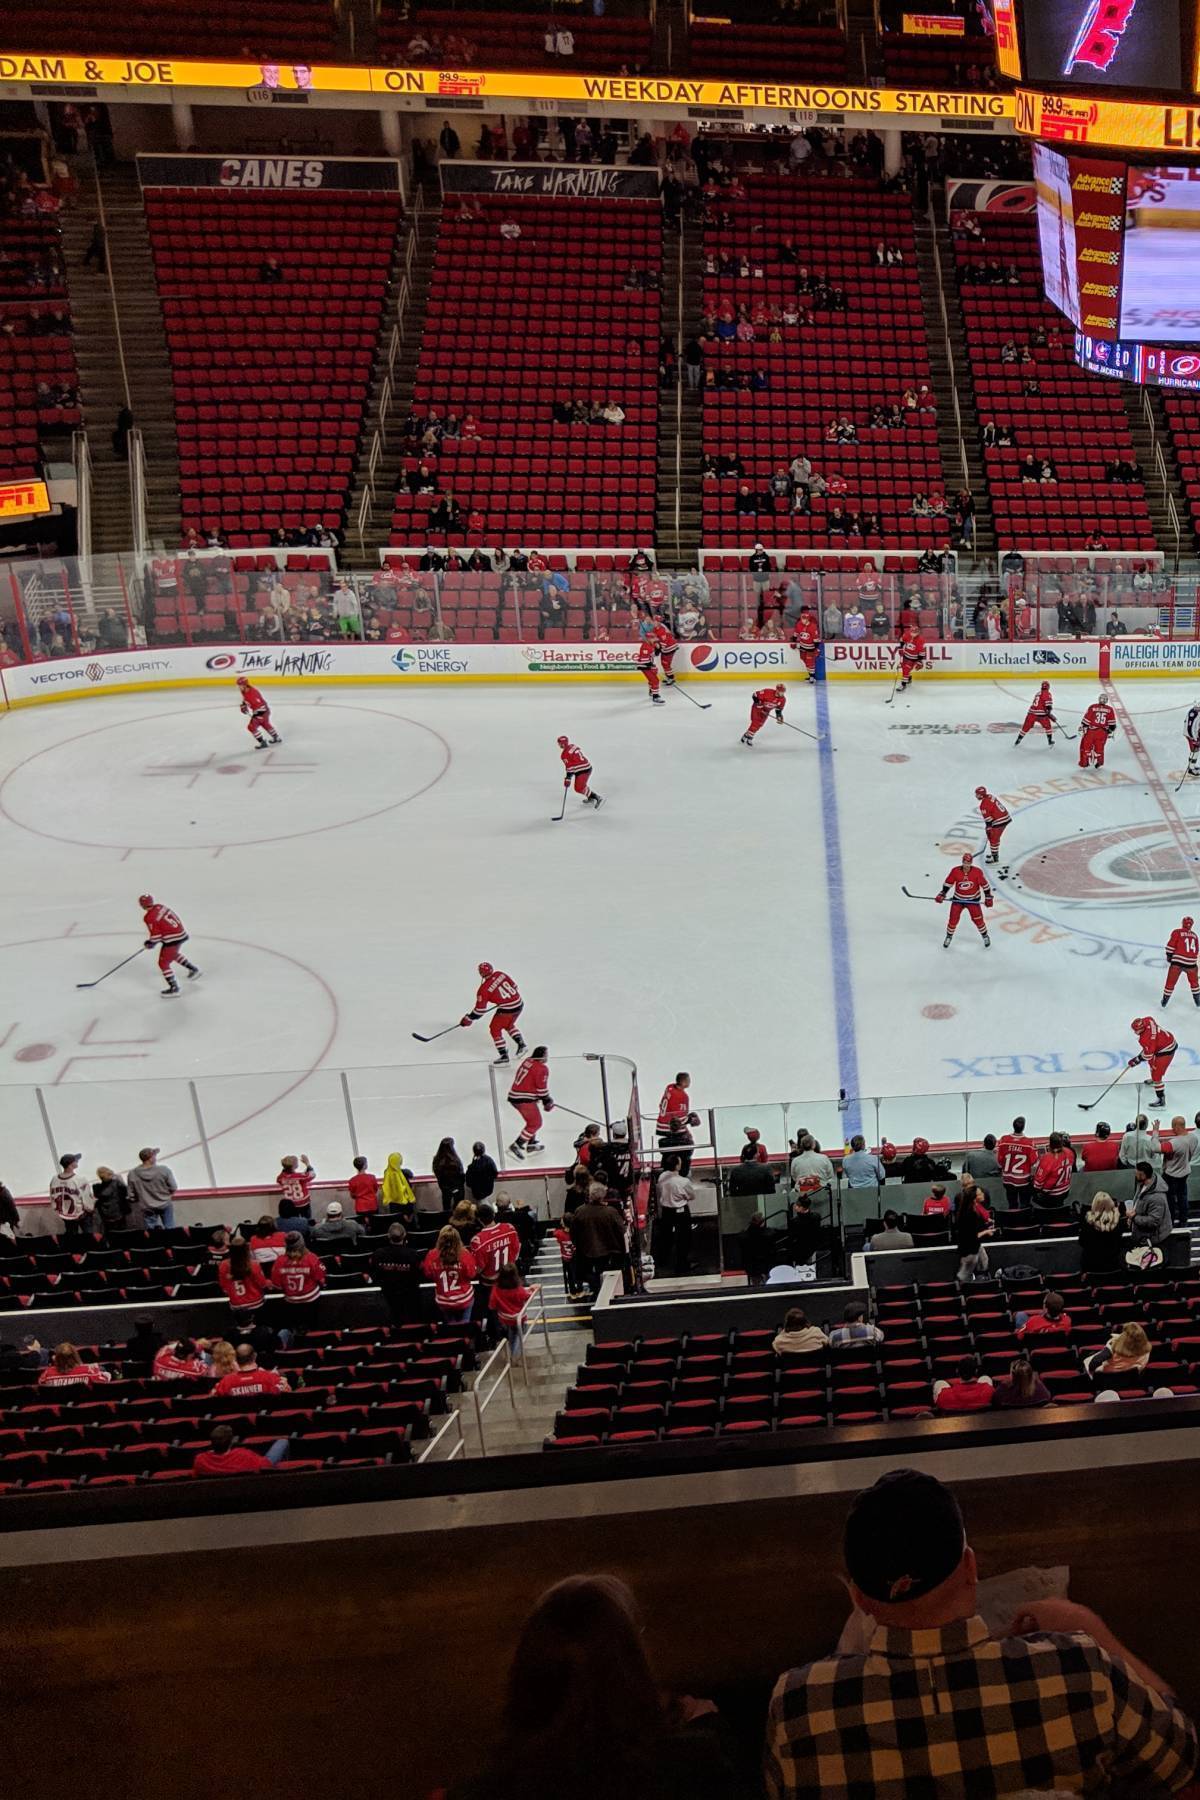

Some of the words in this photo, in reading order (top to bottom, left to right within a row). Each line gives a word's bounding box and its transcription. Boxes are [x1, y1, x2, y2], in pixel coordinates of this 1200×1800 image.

[84, 60, 104, 81] &
[120, 62, 174, 83] JOE
[384, 71, 425, 92] ON
[439, 72, 459, 81] 99.9
[583, 79, 705, 102] WEEKDAY
[719, 84, 882, 111] AFTERNOONS
[896, 92, 1005, 116] STARTING
[1017, 92, 1036, 131] ON
[1042, 96, 1064, 114] 99.9
[220, 159, 325, 188] CANES
[491, 167, 534, 193] TAKE
[543, 167, 624, 198] WARNING
[1148, 355, 1155, 369] 0
[418, 649, 451, 661] DUKE
[542, 650, 593, 662] Harris
[597, 650, 640, 662] Teete
[725, 649, 785, 669] pepsi
[834, 646, 899, 660] BULLY
[979, 651, 1030, 665] Michael
[1063, 651, 1087, 665] Son
[1115, 645, 1159, 659] RALEIGH
[239, 650, 272, 670] TAKE
[275, 650, 336, 677] WARNING
[419, 660, 469, 673] ENERGY
[1125, 660, 1159, 668] OFFICIAL
[1163, 660, 1184, 668] TEAM
[30, 669, 85, 686] VECTOR
[105, 660, 171, 675] SECURITY
[1095, 712, 1106, 725] 35
[1184, 937, 1197, 953] 14
[498, 981, 516, 1000] 48
[1004, 1154, 1027, 1173] 12
[494, 1237, 511, 1250] STAAL
[494, 1246, 510, 1271] 11
[234, 1280, 246, 1296] 5
[287, 1274, 304, 1291] 57
[440, 1270, 461, 1292] 12
